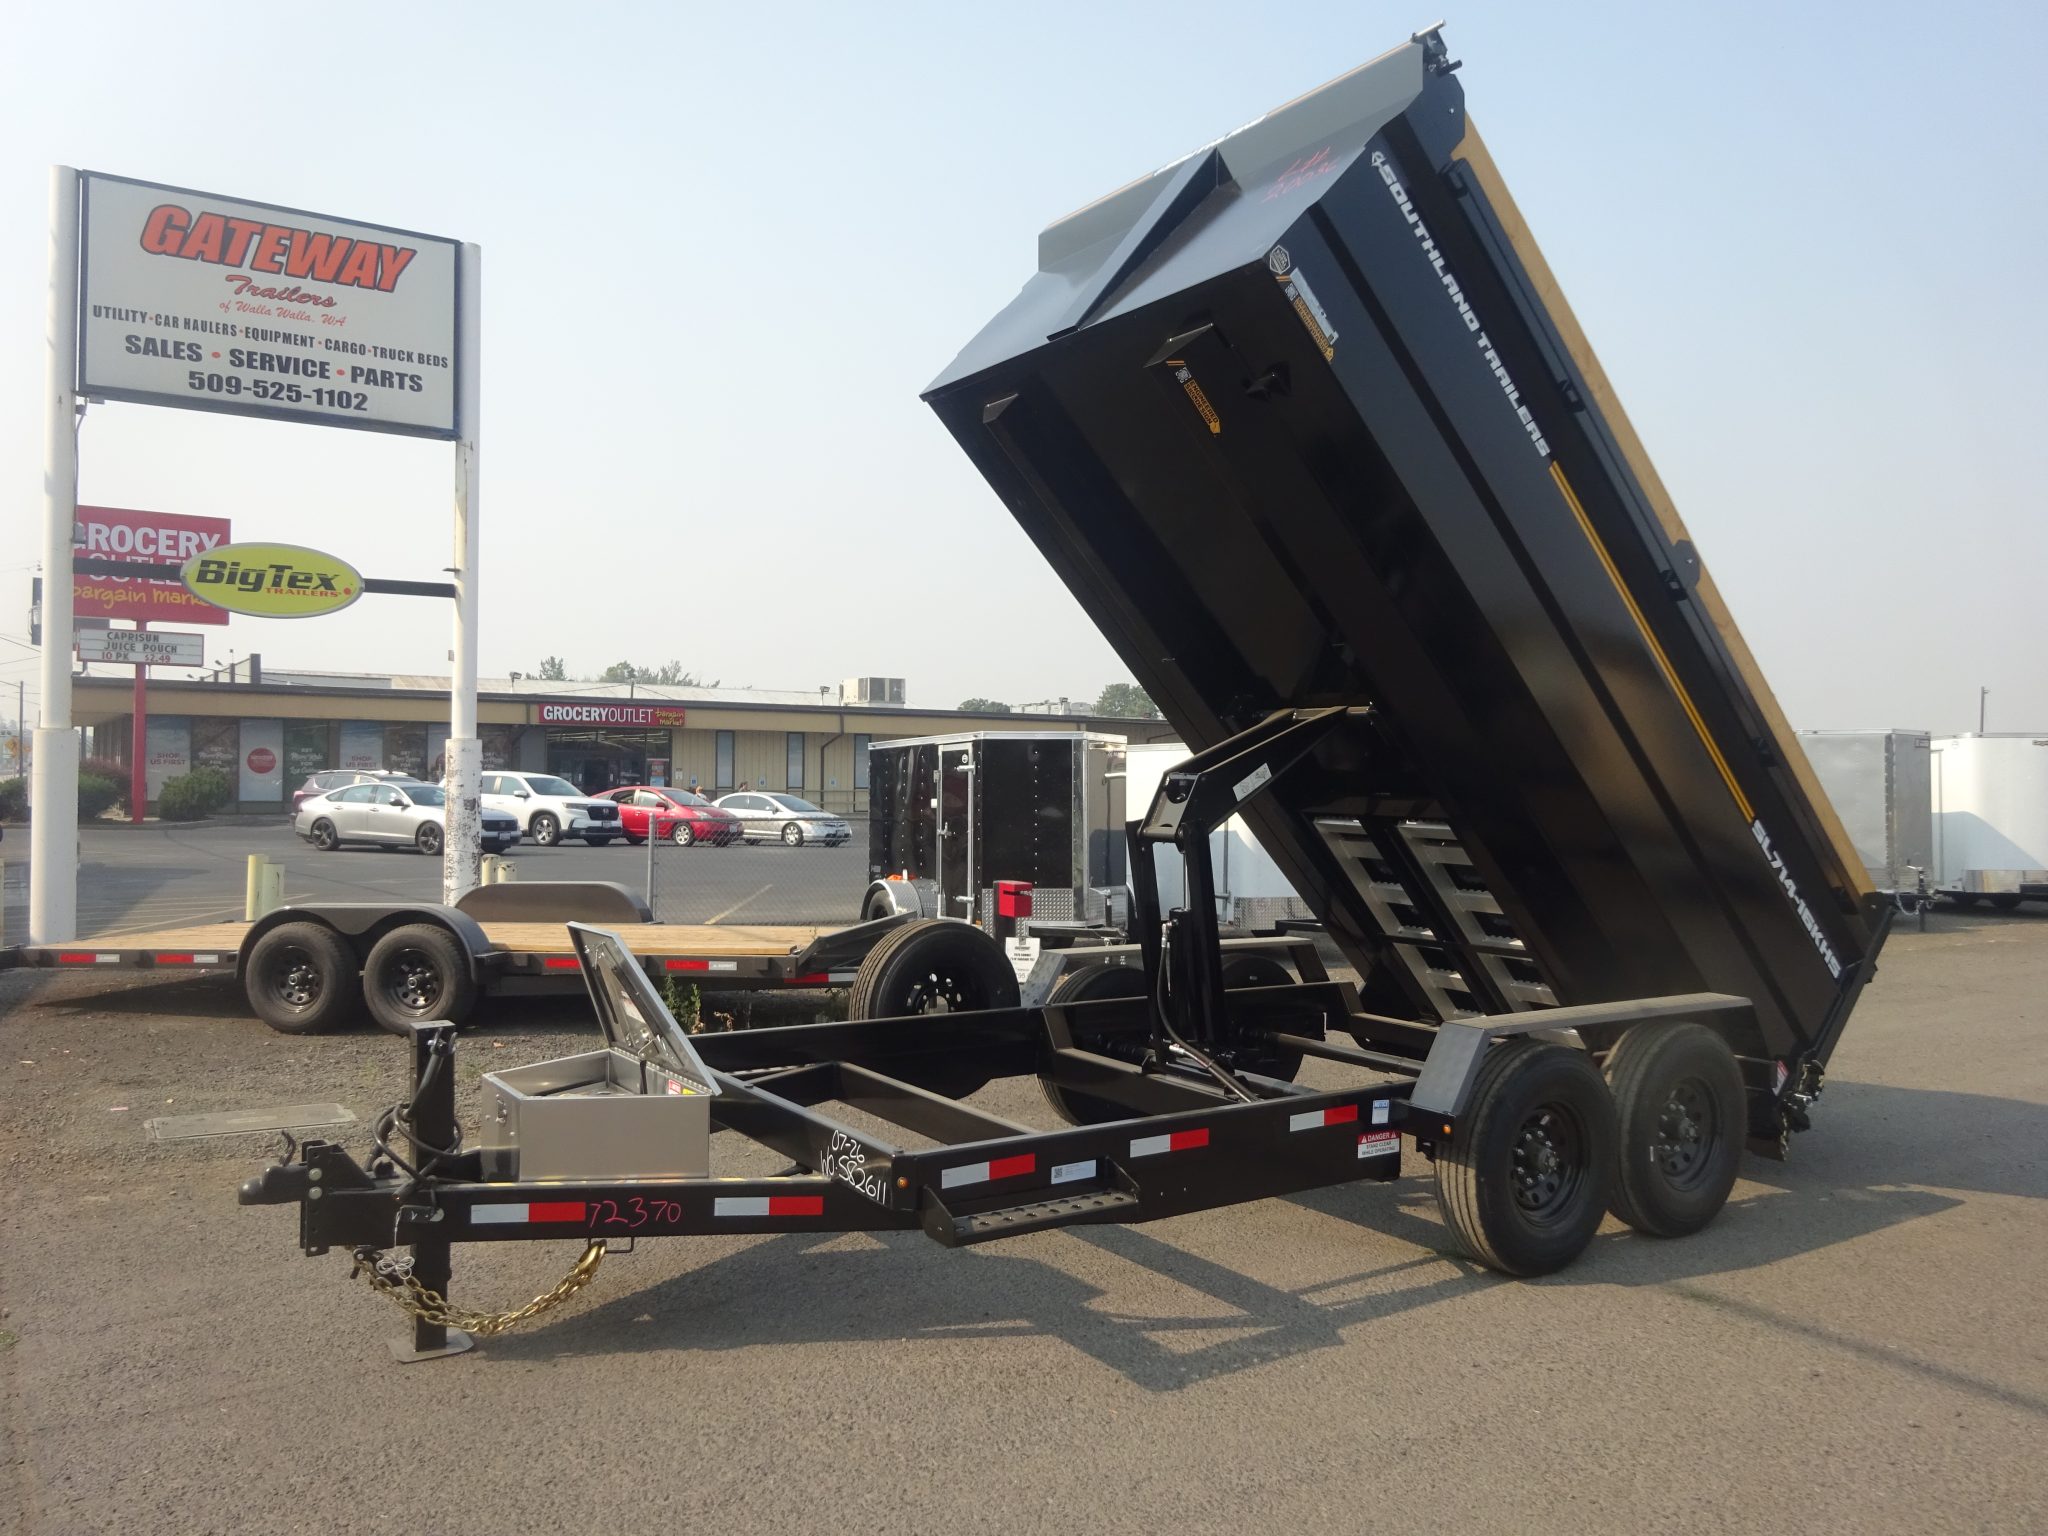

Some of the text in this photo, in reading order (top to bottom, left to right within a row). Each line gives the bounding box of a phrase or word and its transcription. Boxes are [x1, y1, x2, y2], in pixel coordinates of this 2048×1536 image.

[140, 204, 417, 293] GATEWAY
[225, 274, 338, 308] Trailers
[219, 300, 231, 313] of
[235, 301, 272, 316] Walla
[321, 313, 347, 327] WA
[1379, 164, 1550, 457] SOUTHLAND TRAILERS
[125, 334, 423, 393] SALES SERVICE PARTS
[418, 352, 448, 369] BEDS
[189, 370, 369, 412] 509-525-1102
[74, 522, 221, 558] ROCERY
[196, 559, 340, 593] BigTex
[265, 587, 339, 598] TRAILERS
[104, 642, 178, 654] JUICE POUCH
[106, 631, 160, 643] CAPRISUN
[116, 652, 129, 660] PK
[655, 708, 684, 721] bargain
[831, 1129, 865, 1163] 07-26
[1367, 1132, 1390, 1142] DANGER
[589, 1197, 682, 1228] 72370
